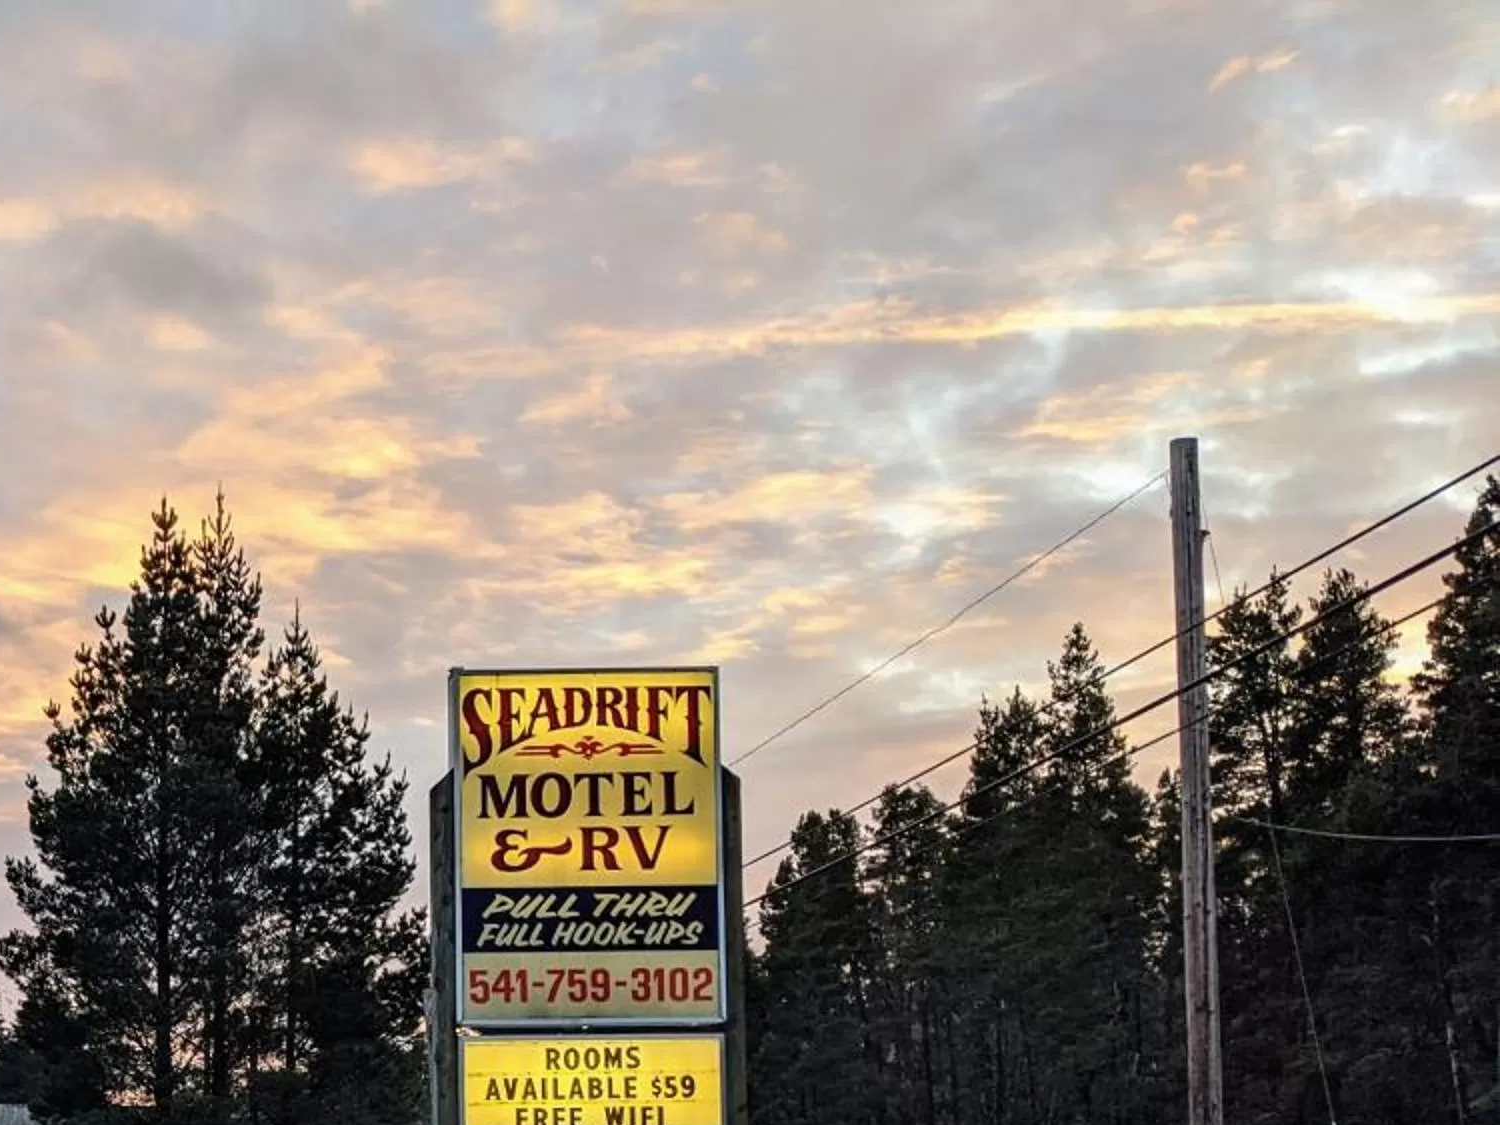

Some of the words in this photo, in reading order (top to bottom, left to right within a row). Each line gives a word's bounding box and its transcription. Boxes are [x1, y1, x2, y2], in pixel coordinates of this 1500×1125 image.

[462, 685, 711, 779] SEADRIFT
[477, 771, 695, 819] MOTEL
[491, 829, 573, 873] &
[579, 825, 672, 872] RV
[482, 893, 581, 919] PULL
[591, 891, 698, 918] THRU
[476, 922, 545, 948] FULL
[551, 920, 705, 946] HOOK-UPS
[468, 967, 714, 1005] 541-759-3102
[545, 1046, 641, 1071] ROOMS
[485, 1076, 638, 1101] AVAILABLE
[651, 1075, 696, 1099] $59
